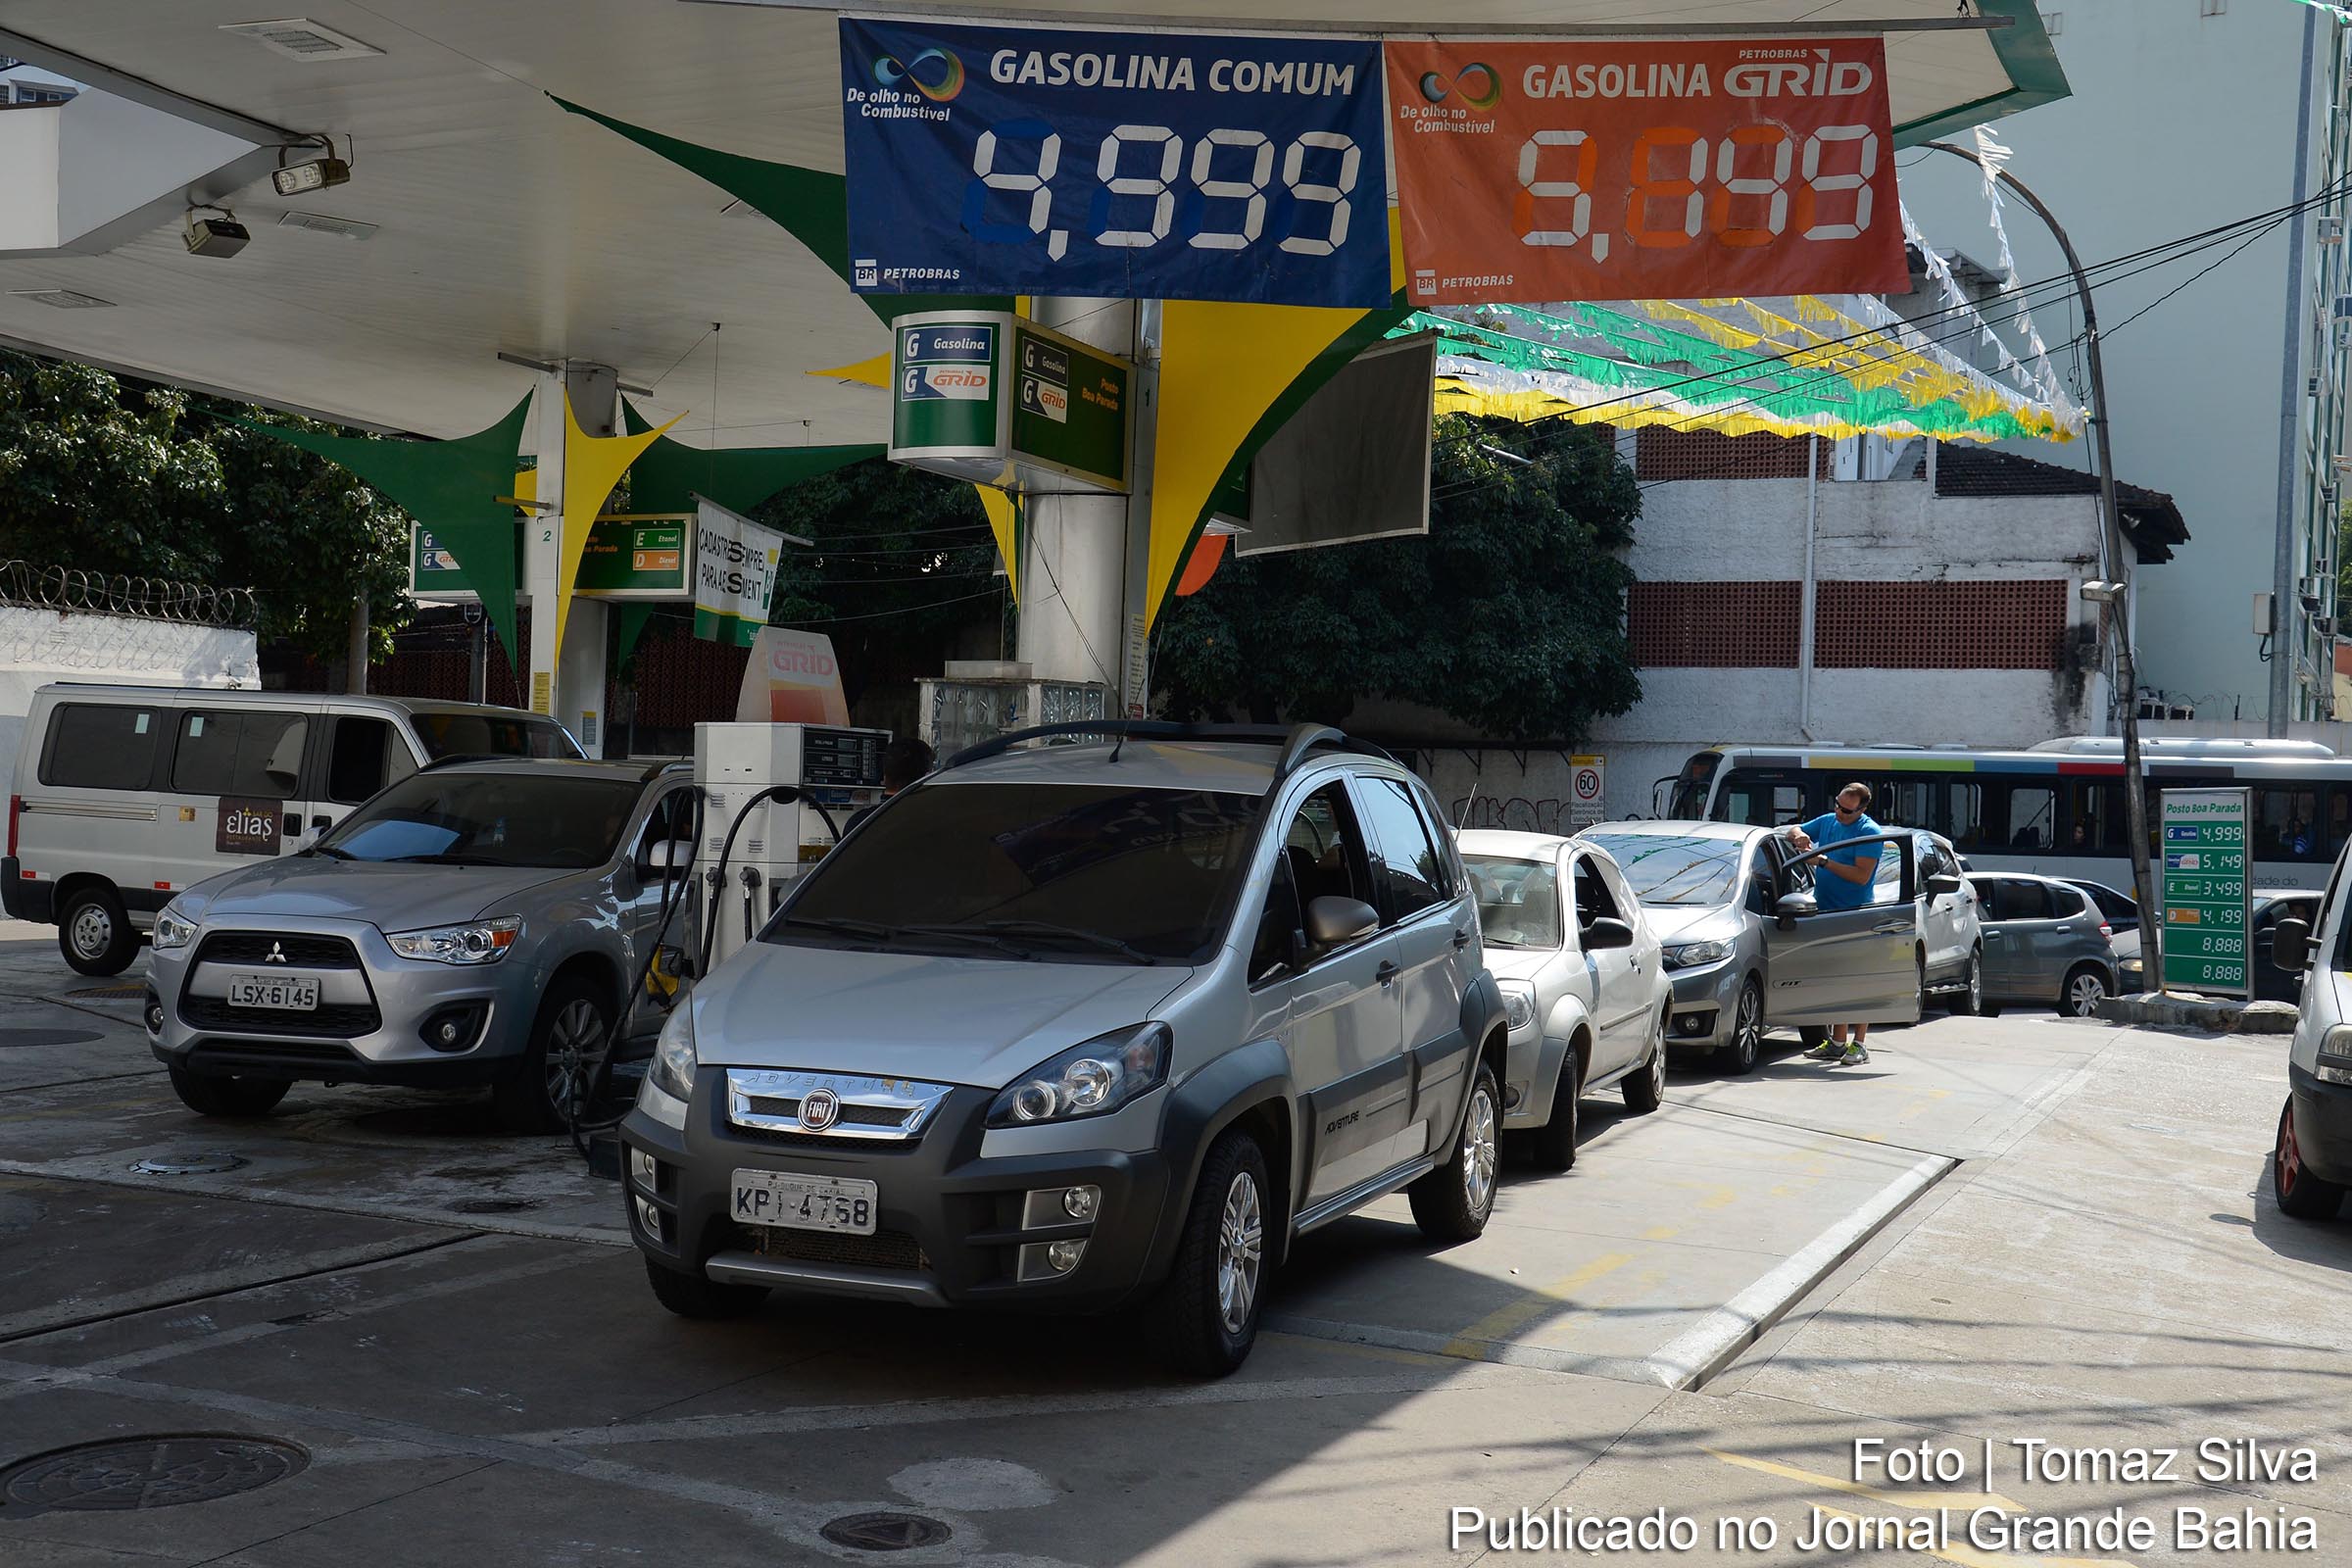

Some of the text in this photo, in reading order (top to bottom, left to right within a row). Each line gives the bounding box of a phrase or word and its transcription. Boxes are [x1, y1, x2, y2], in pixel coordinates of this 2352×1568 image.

[1739, 48, 1808, 59] PETROBRAS
[990, 49, 1355, 95] GASOLINA COMUM
[1523, 63, 1711, 98] GASOLINA
[847, 88, 921, 103] De olho no
[861, 103, 951, 122] Combustível
[1400, 105, 1467, 120] De olho no
[1414, 119, 1495, 134] Combustível
[973, 124, 1361, 262] 4,999
[884, 268, 960, 280] PETROBRAS
[1443, 274, 1514, 289] PETROBRAS
[906, 332, 986, 357] G Gasolina
[1024, 344, 1066, 374] G Gasolina
[905, 369, 987, 392] G GRID
[1023, 380, 1066, 410] G GRID
[424, 533, 432, 548] G
[542, 530, 551, 542] 2
[636, 532, 677, 546] E Etanol
[423, 553, 431, 566] G
[635, 553, 645, 567] D
[772, 645, 834, 675] GRID
[1580, 775, 1595, 790] 60
[2167, 803, 2242, 813] Posto Boa Parada
[2168, 828, 2175, 839] G
[2169, 883, 2176, 892] E
[2282, 876, 2298, 886] do
[2169, 909, 2177, 921] D
[807, 1101, 829, 1118] FIAT
[1325, 1110, 1359, 1135] ADVENTURE
